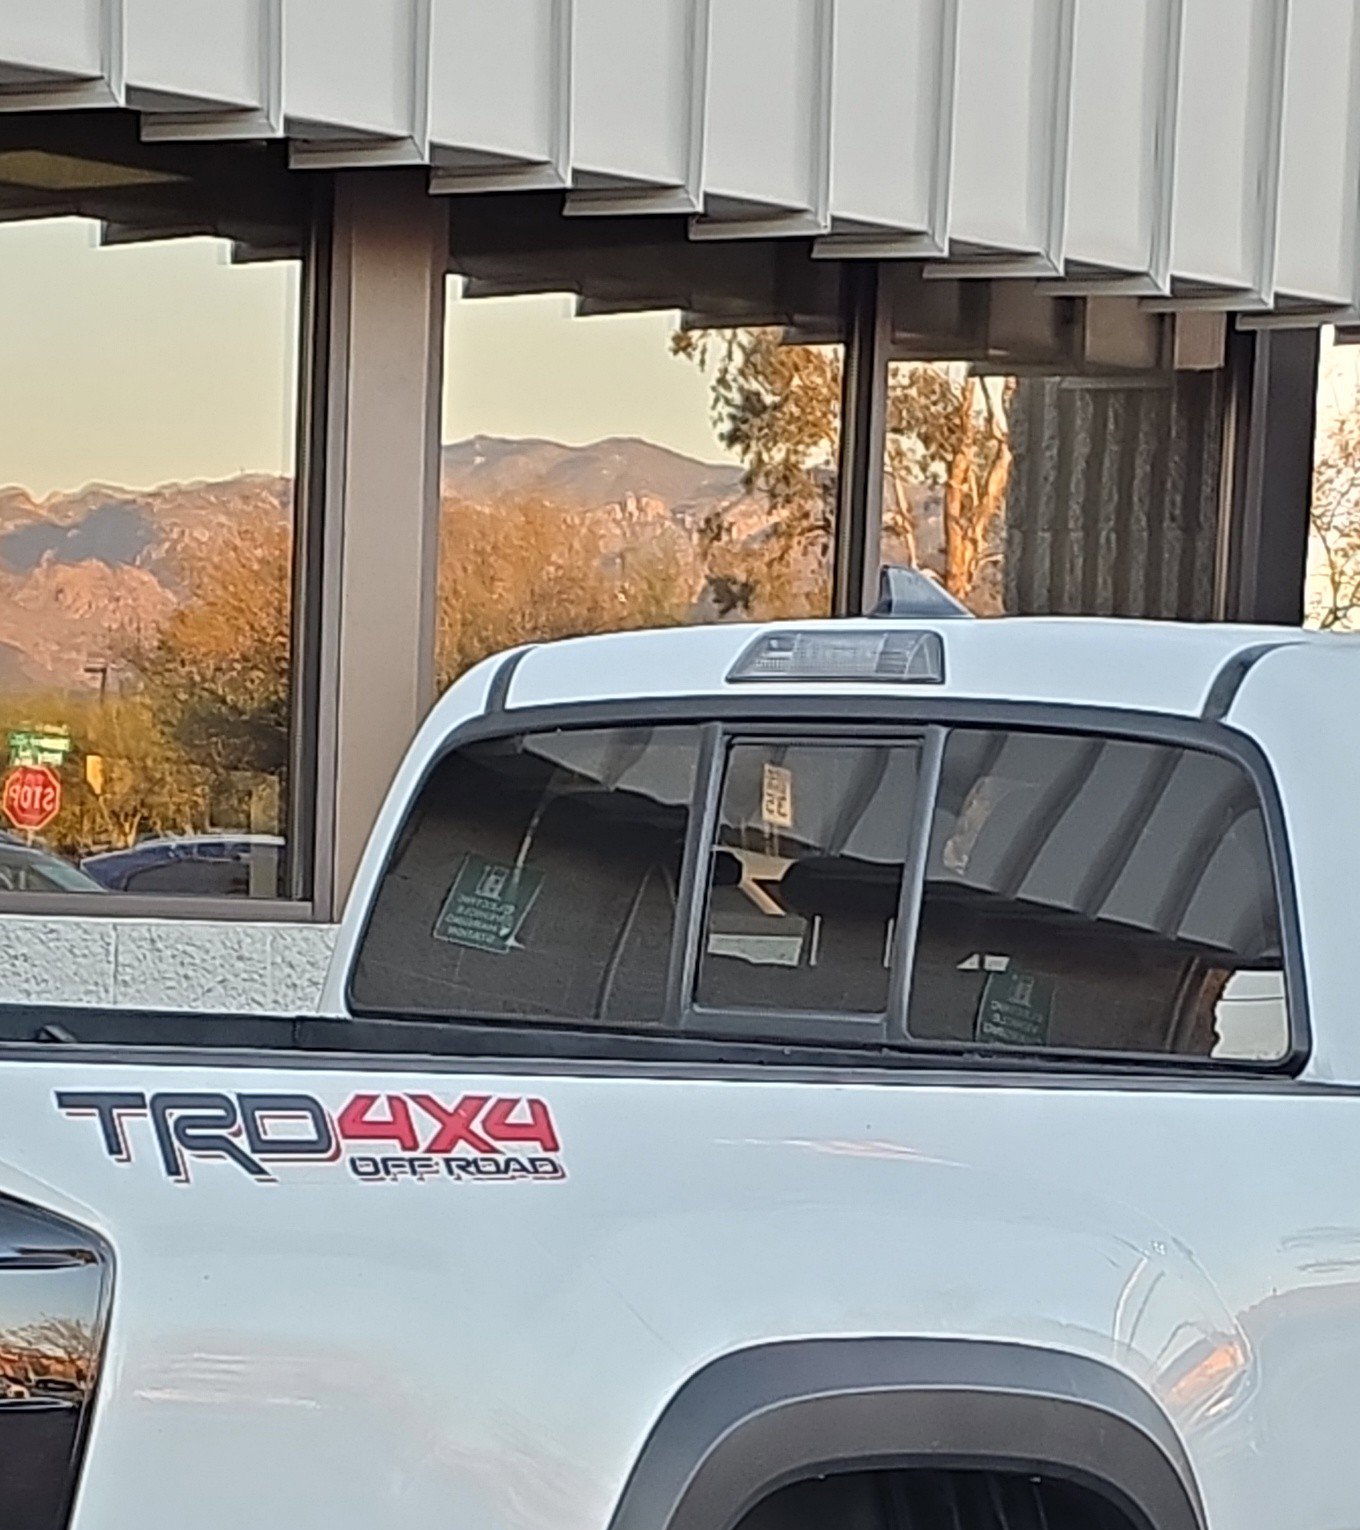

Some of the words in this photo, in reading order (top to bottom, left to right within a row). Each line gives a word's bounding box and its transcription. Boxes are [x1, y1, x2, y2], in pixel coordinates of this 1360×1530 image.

[53, 1090, 340, 1183] TRD
[337, 1093, 560, 1155] 4X4
[350, 1156, 440, 1181] OFF
[443, 1156, 566, 1181] ROAD
